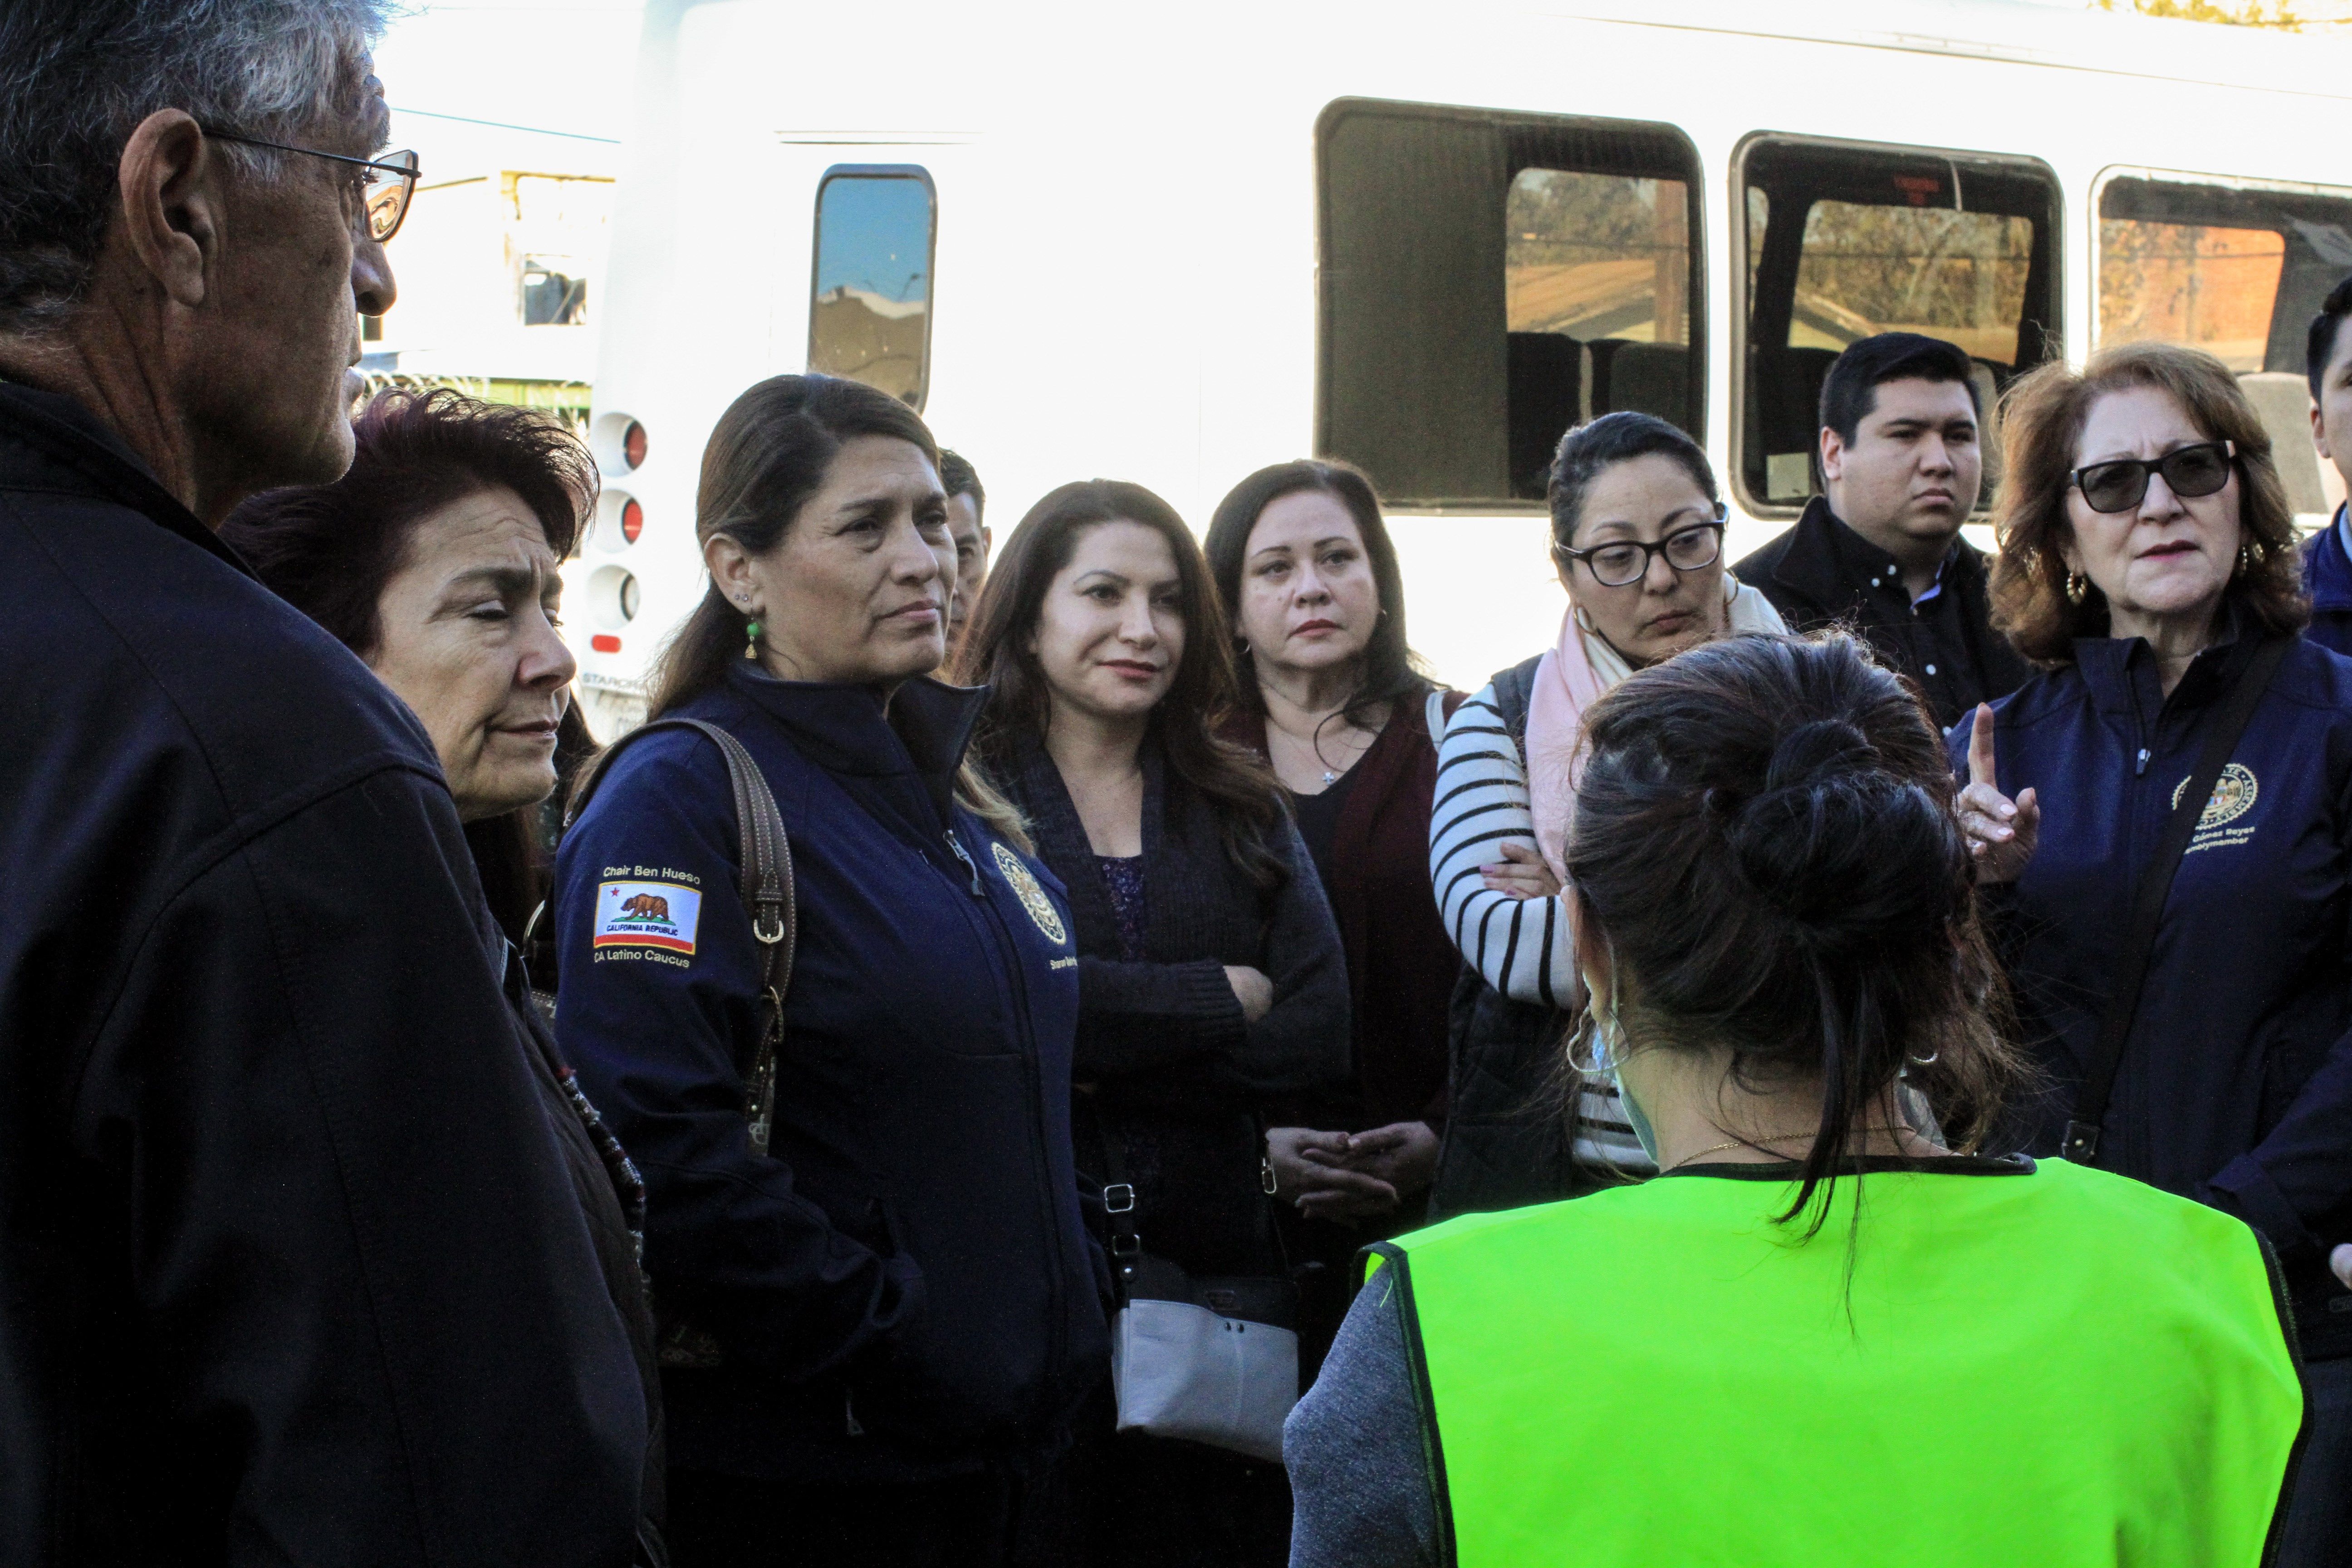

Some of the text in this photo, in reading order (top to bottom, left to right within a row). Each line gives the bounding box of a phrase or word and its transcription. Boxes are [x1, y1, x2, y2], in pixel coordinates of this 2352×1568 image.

[2226, 826, 2256, 837] Reyes
[603, 865, 701, 885] Chair Ben Hueso
[645, 925, 679, 936] REPUBLIC
[594, 949, 690, 969] CA Latino Caucus
